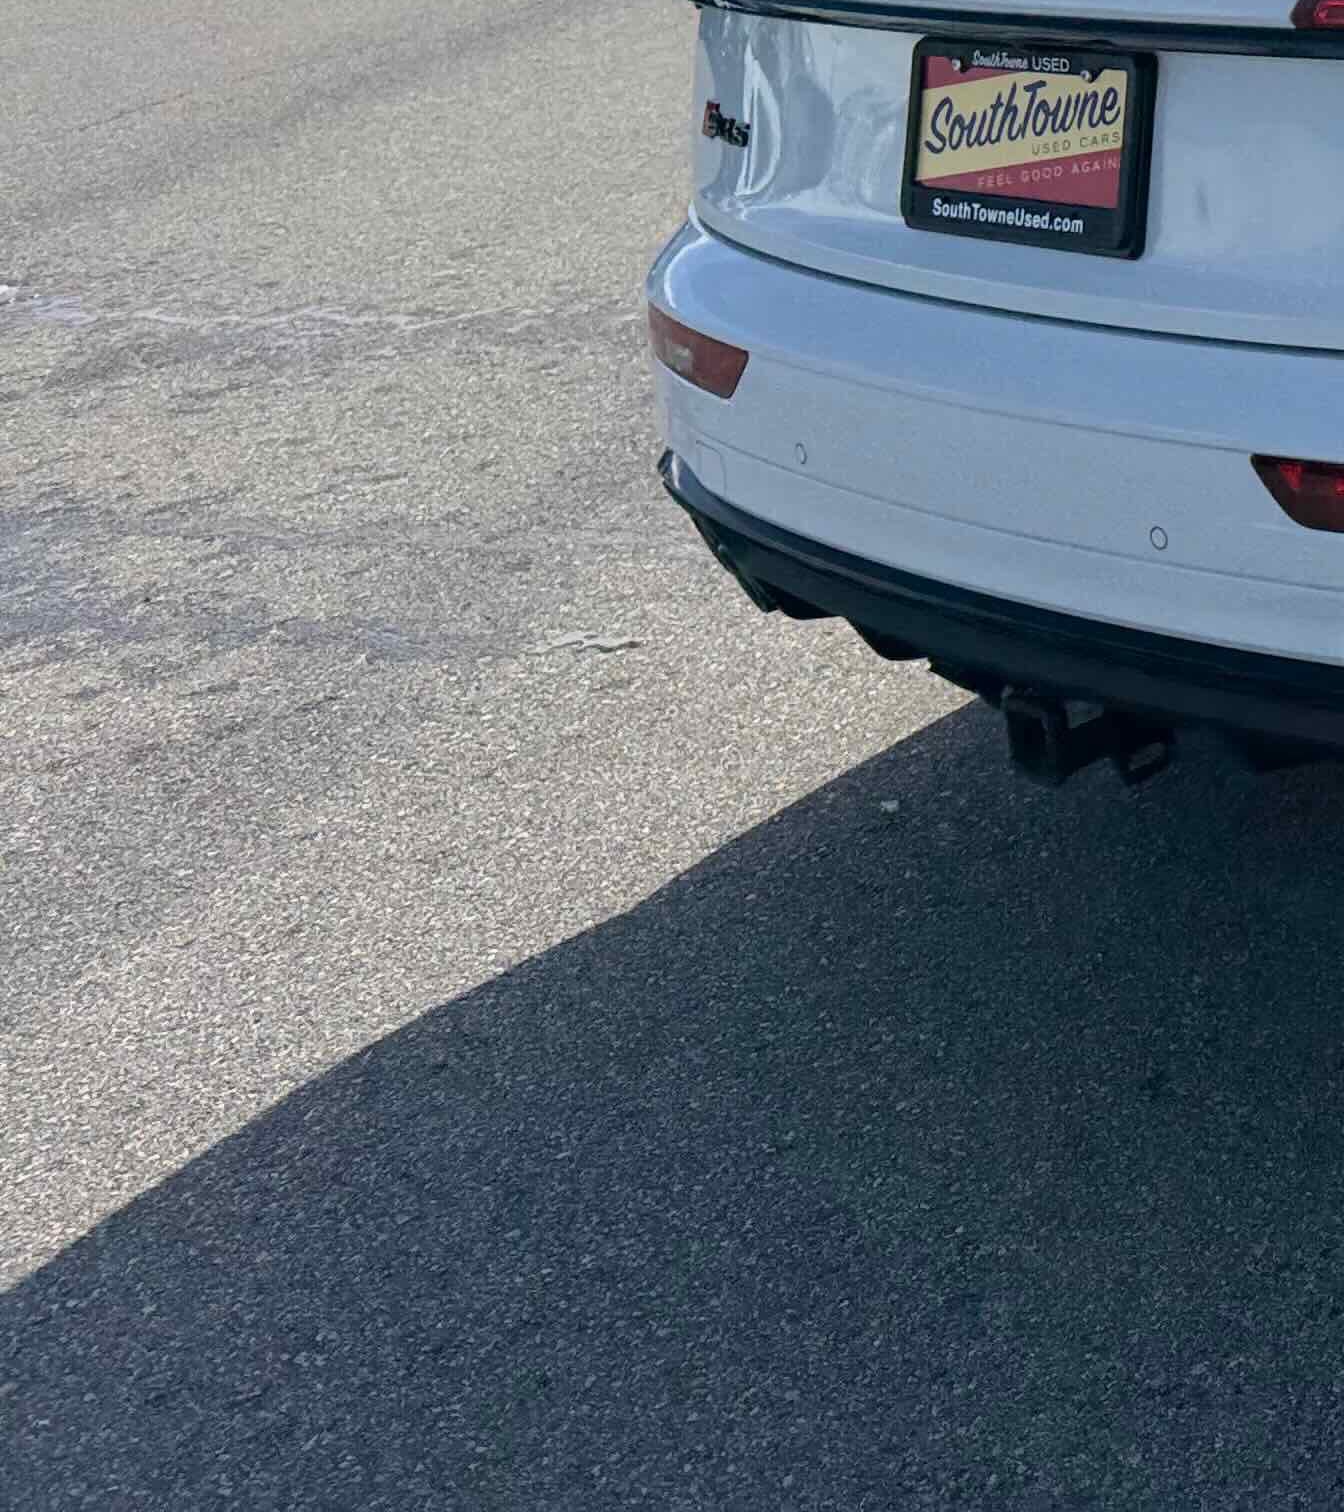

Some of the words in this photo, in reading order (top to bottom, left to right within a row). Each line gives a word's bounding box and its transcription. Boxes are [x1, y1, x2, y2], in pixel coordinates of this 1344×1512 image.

[1032, 56, 1070, 73] USED
[925, 80, 1121, 155] SouthTowne
[1031, 141, 1071, 157] USED
[1079, 131, 1121, 149] CARS
[977, 173, 1013, 188] FEEL
[1021, 166, 1063, 183] GOOD
[932, 197, 1084, 234] SouthTowneUsed.com
